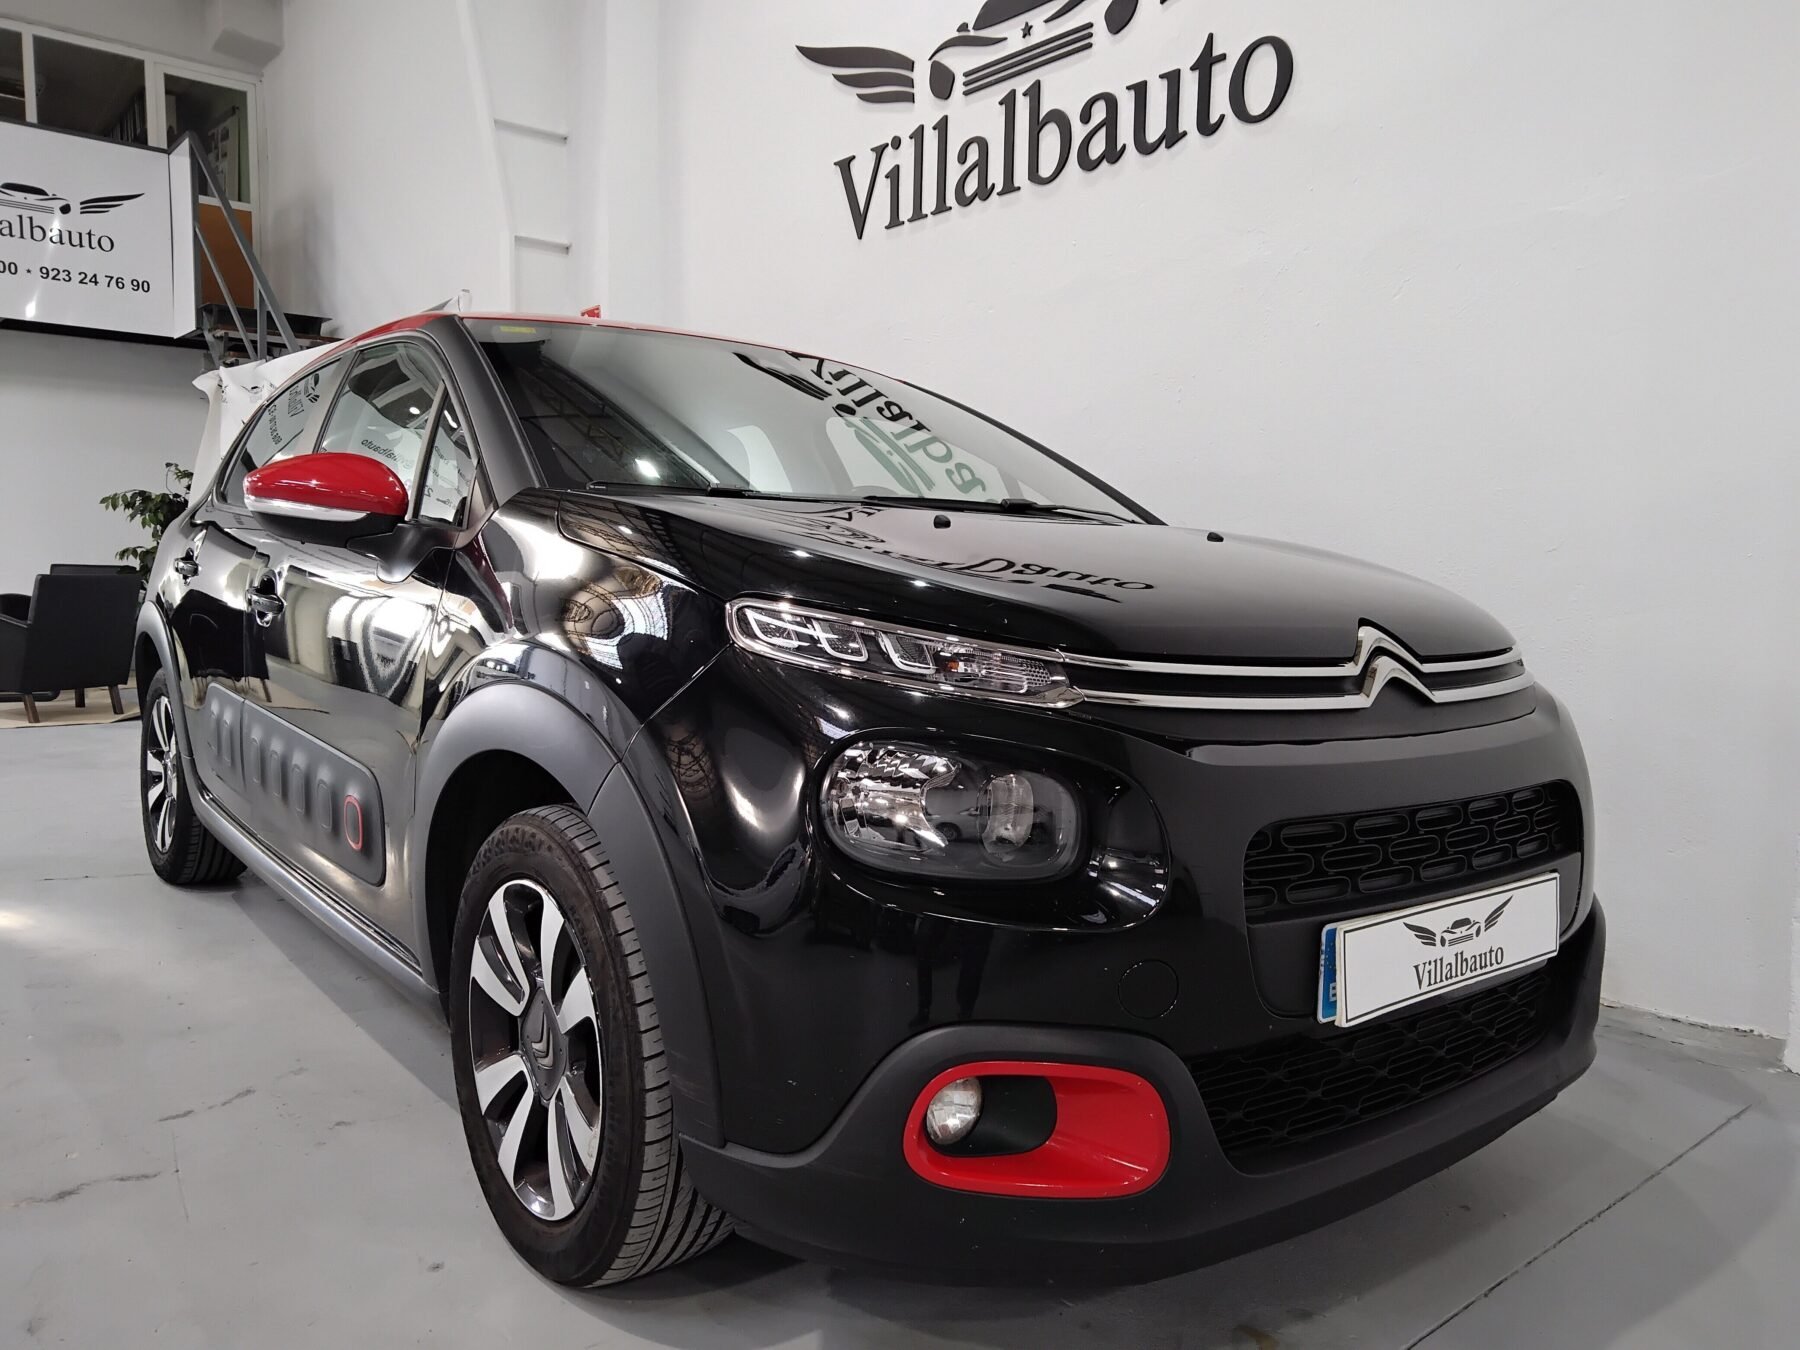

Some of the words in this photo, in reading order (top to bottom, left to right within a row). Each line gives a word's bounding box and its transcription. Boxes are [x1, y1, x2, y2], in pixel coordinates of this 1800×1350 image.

[833, 32, 1294, 240] Villalbauto
[0, 214, 114, 253] albauto
[39, 266, 72, 283] 923
[78, 271, 99, 287] 24
[104, 275, 125, 290] 76
[130, 279, 151, 293] 90
[1412, 946, 1504, 990] Villalbauto
